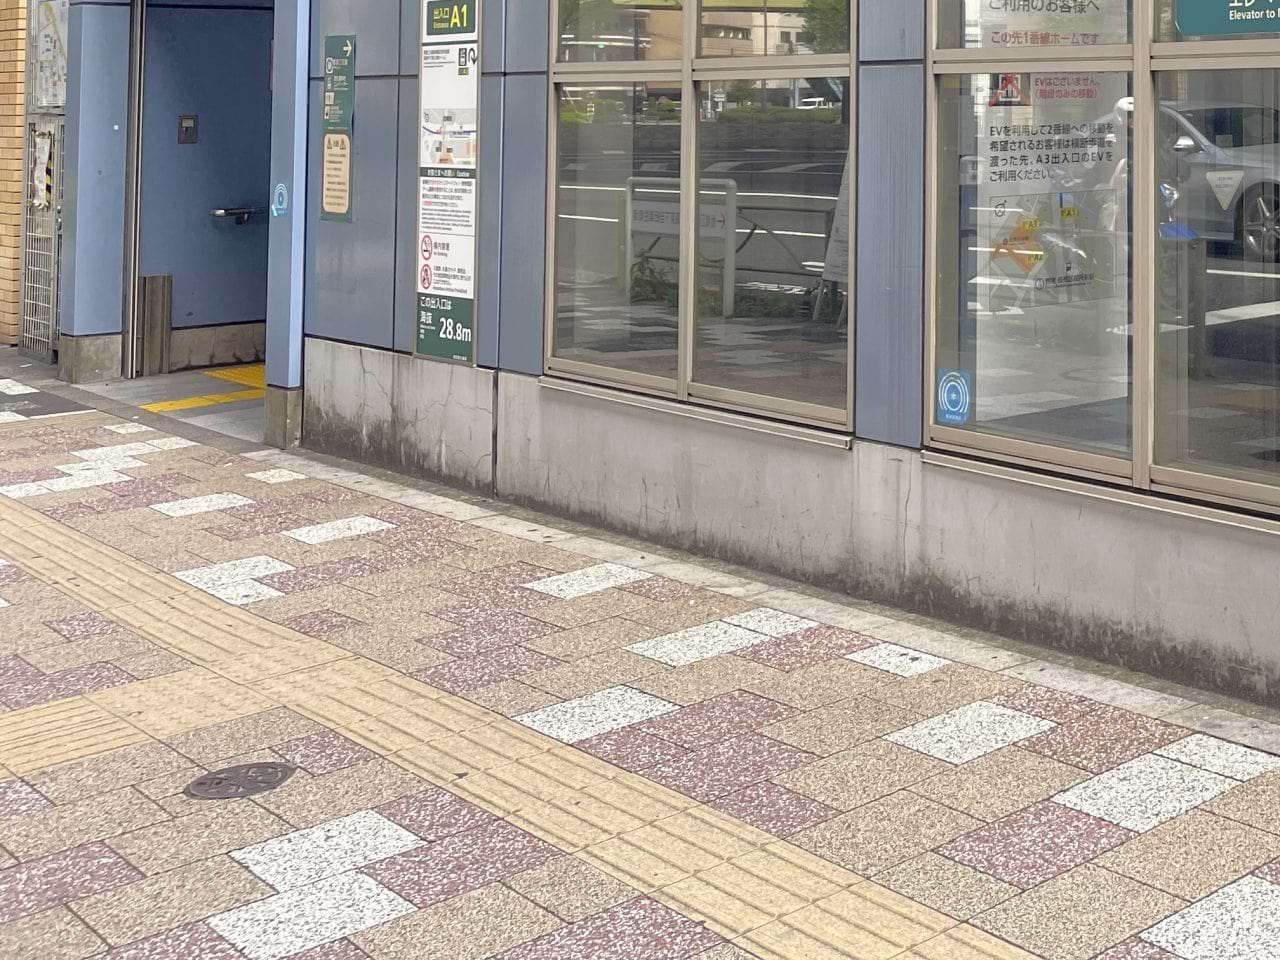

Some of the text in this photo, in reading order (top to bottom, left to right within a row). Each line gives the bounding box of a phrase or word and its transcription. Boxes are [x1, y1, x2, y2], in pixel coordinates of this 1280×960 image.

[450, 4, 468, 28] A1
[1228, 7, 1263, 21] Elevator
[1265, 9, 1276, 19] to
[439, 316, 472, 343] 28.8m
